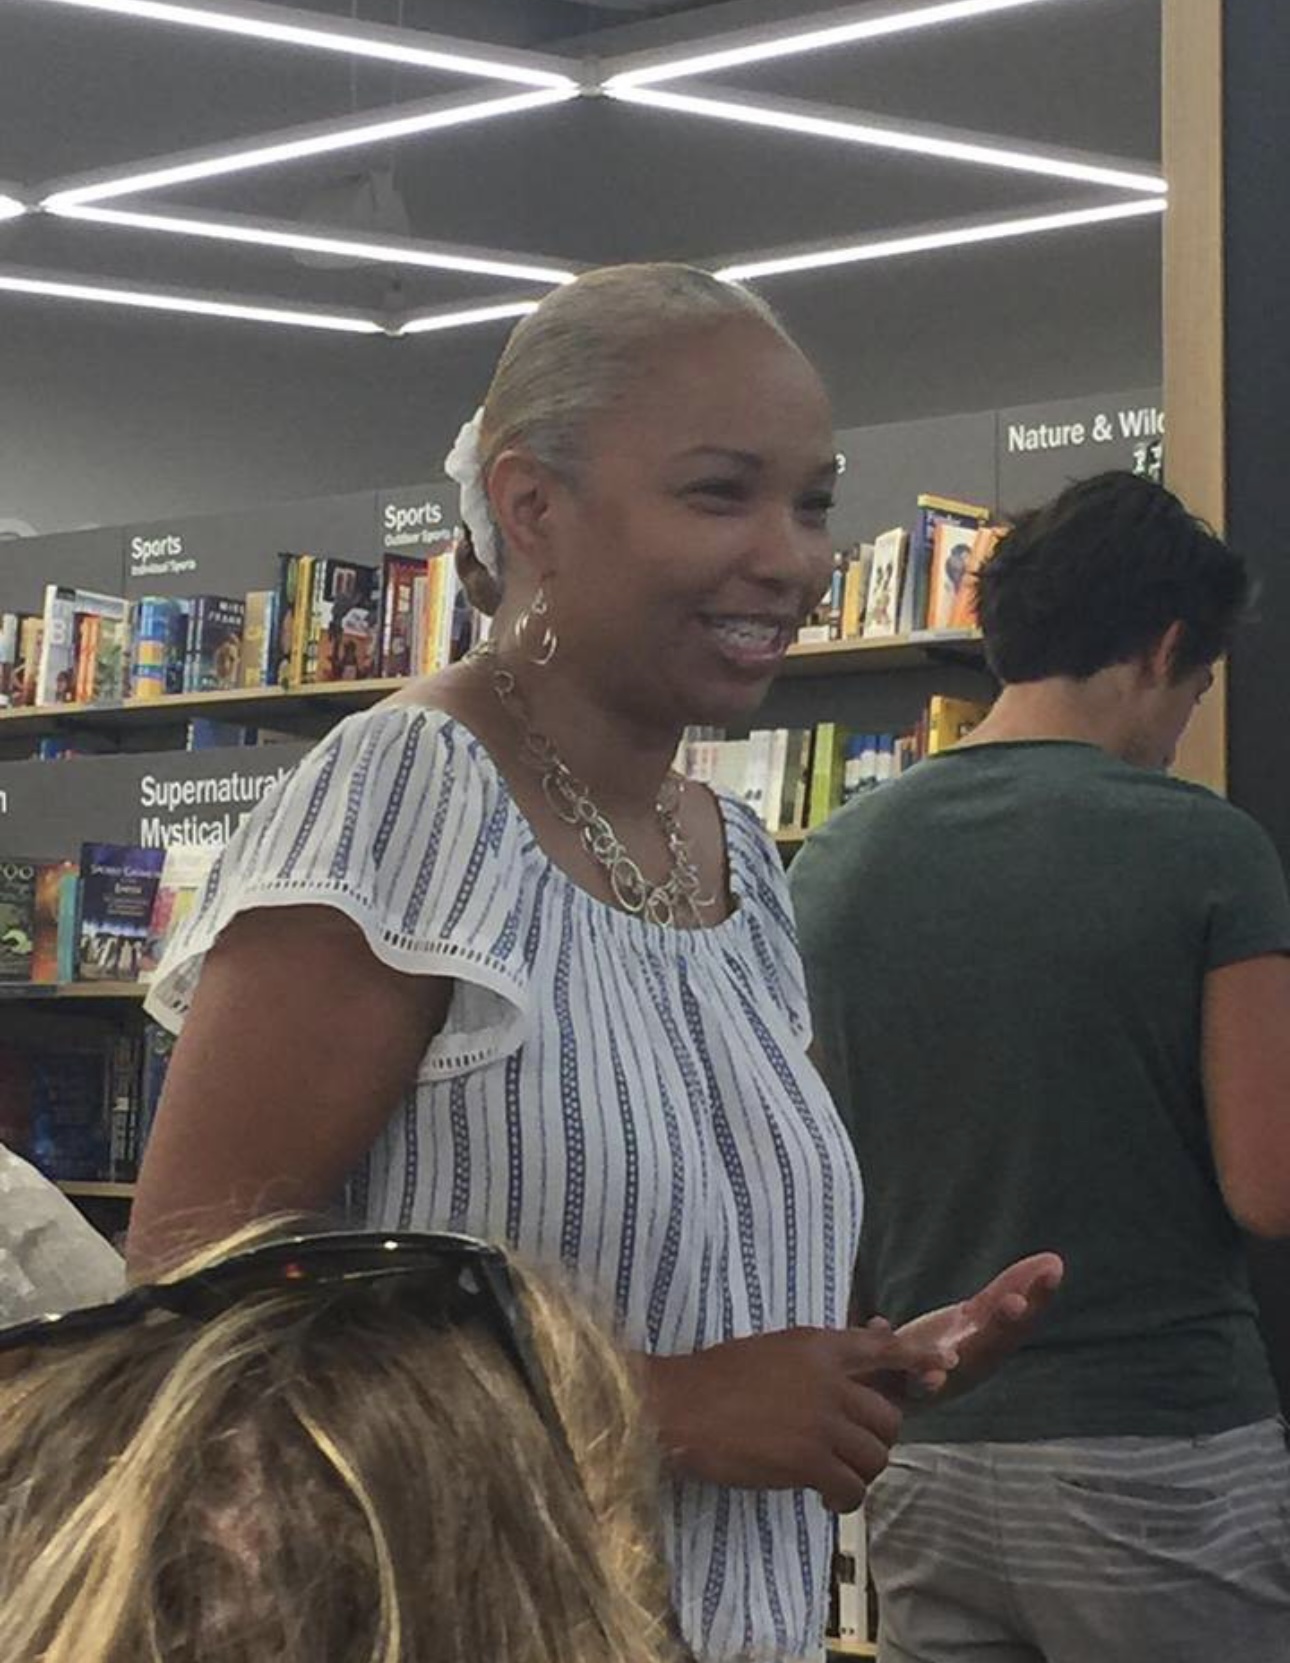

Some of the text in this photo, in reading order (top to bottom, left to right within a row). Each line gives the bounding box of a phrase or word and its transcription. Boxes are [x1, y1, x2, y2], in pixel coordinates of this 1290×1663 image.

[1008, 423, 1085, 451] Nature
[1092, 414, 1113, 441] &
[384, 502, 442, 532] Sports
[131, 535, 182, 563] Sports
[141, 814, 230, 848] Mystical
